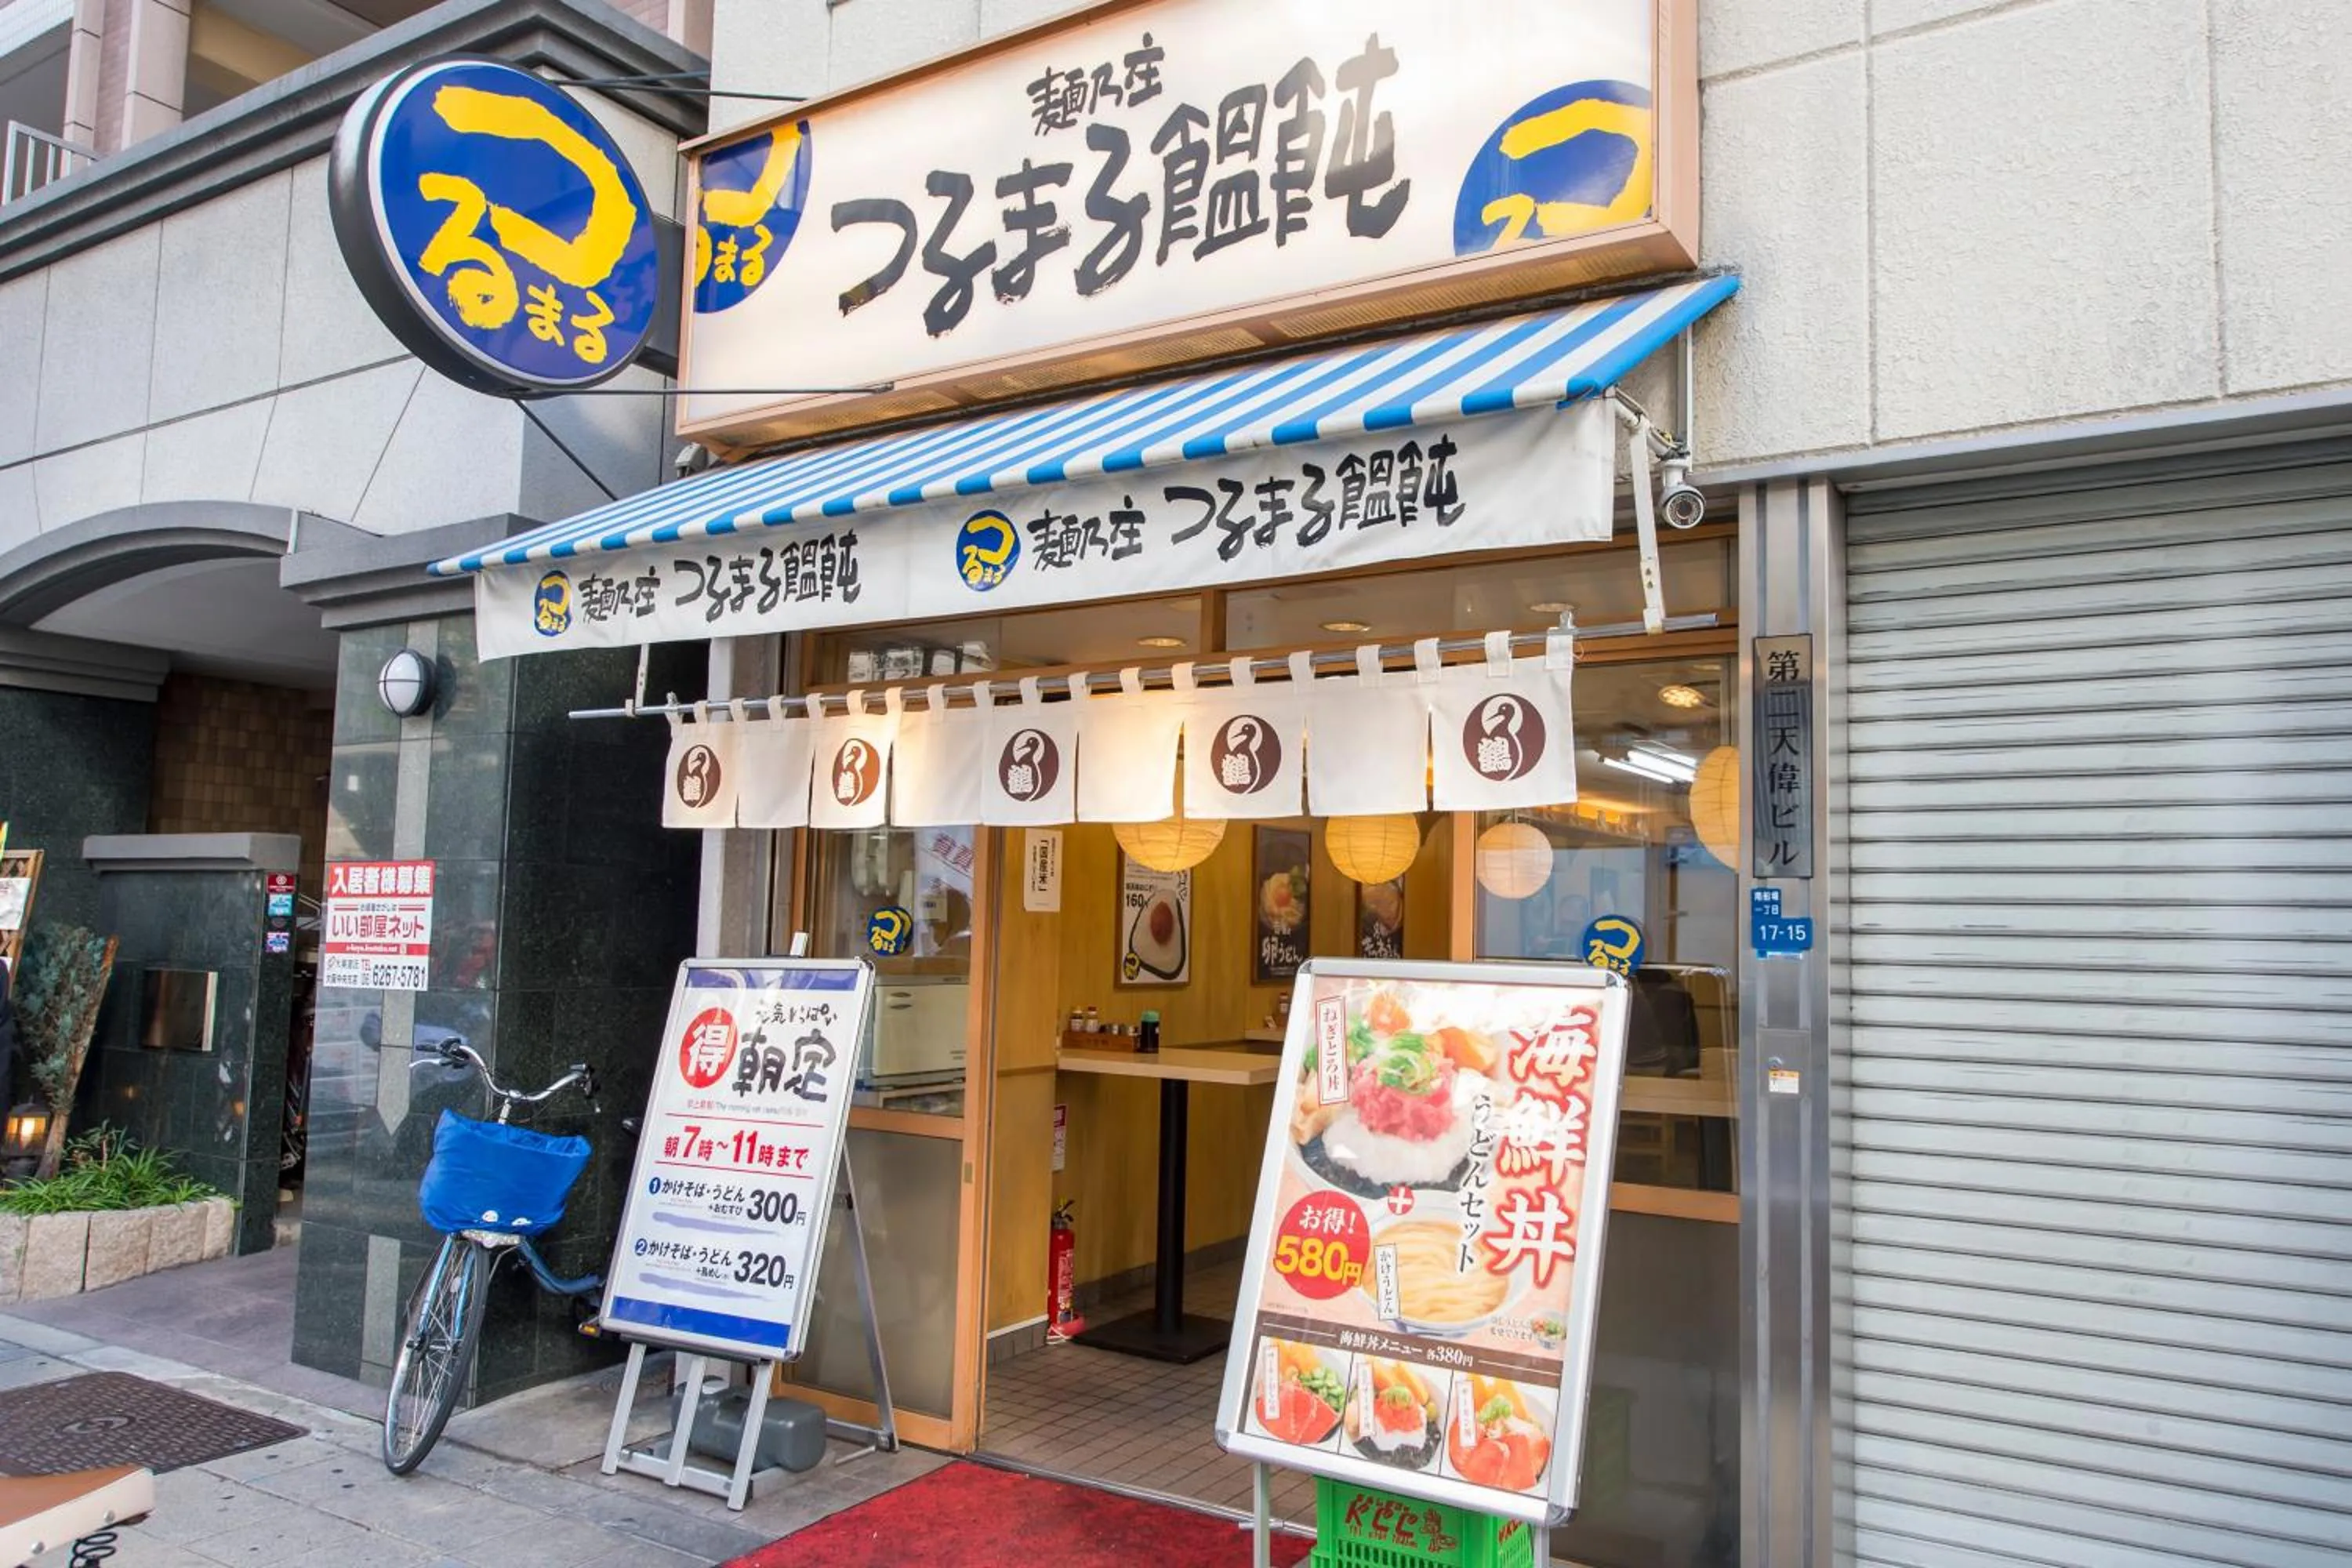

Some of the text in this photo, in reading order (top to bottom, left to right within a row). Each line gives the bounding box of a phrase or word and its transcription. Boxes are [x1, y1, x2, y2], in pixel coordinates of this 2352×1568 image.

[332, 914, 425, 939] いい部屋ネット
[1760, 924, 1807, 941] 17-15
[686, 1021, 730, 1078] 得
[1483, 1007, 1598, 1287] 海鮮丼
[1457, 1094, 1496, 1273] うどんセット
[746, 1189, 807, 1226] 300円
[733, 1250, 795, 1290] 320円
[1276, 1235, 1364, 1287] 580円
